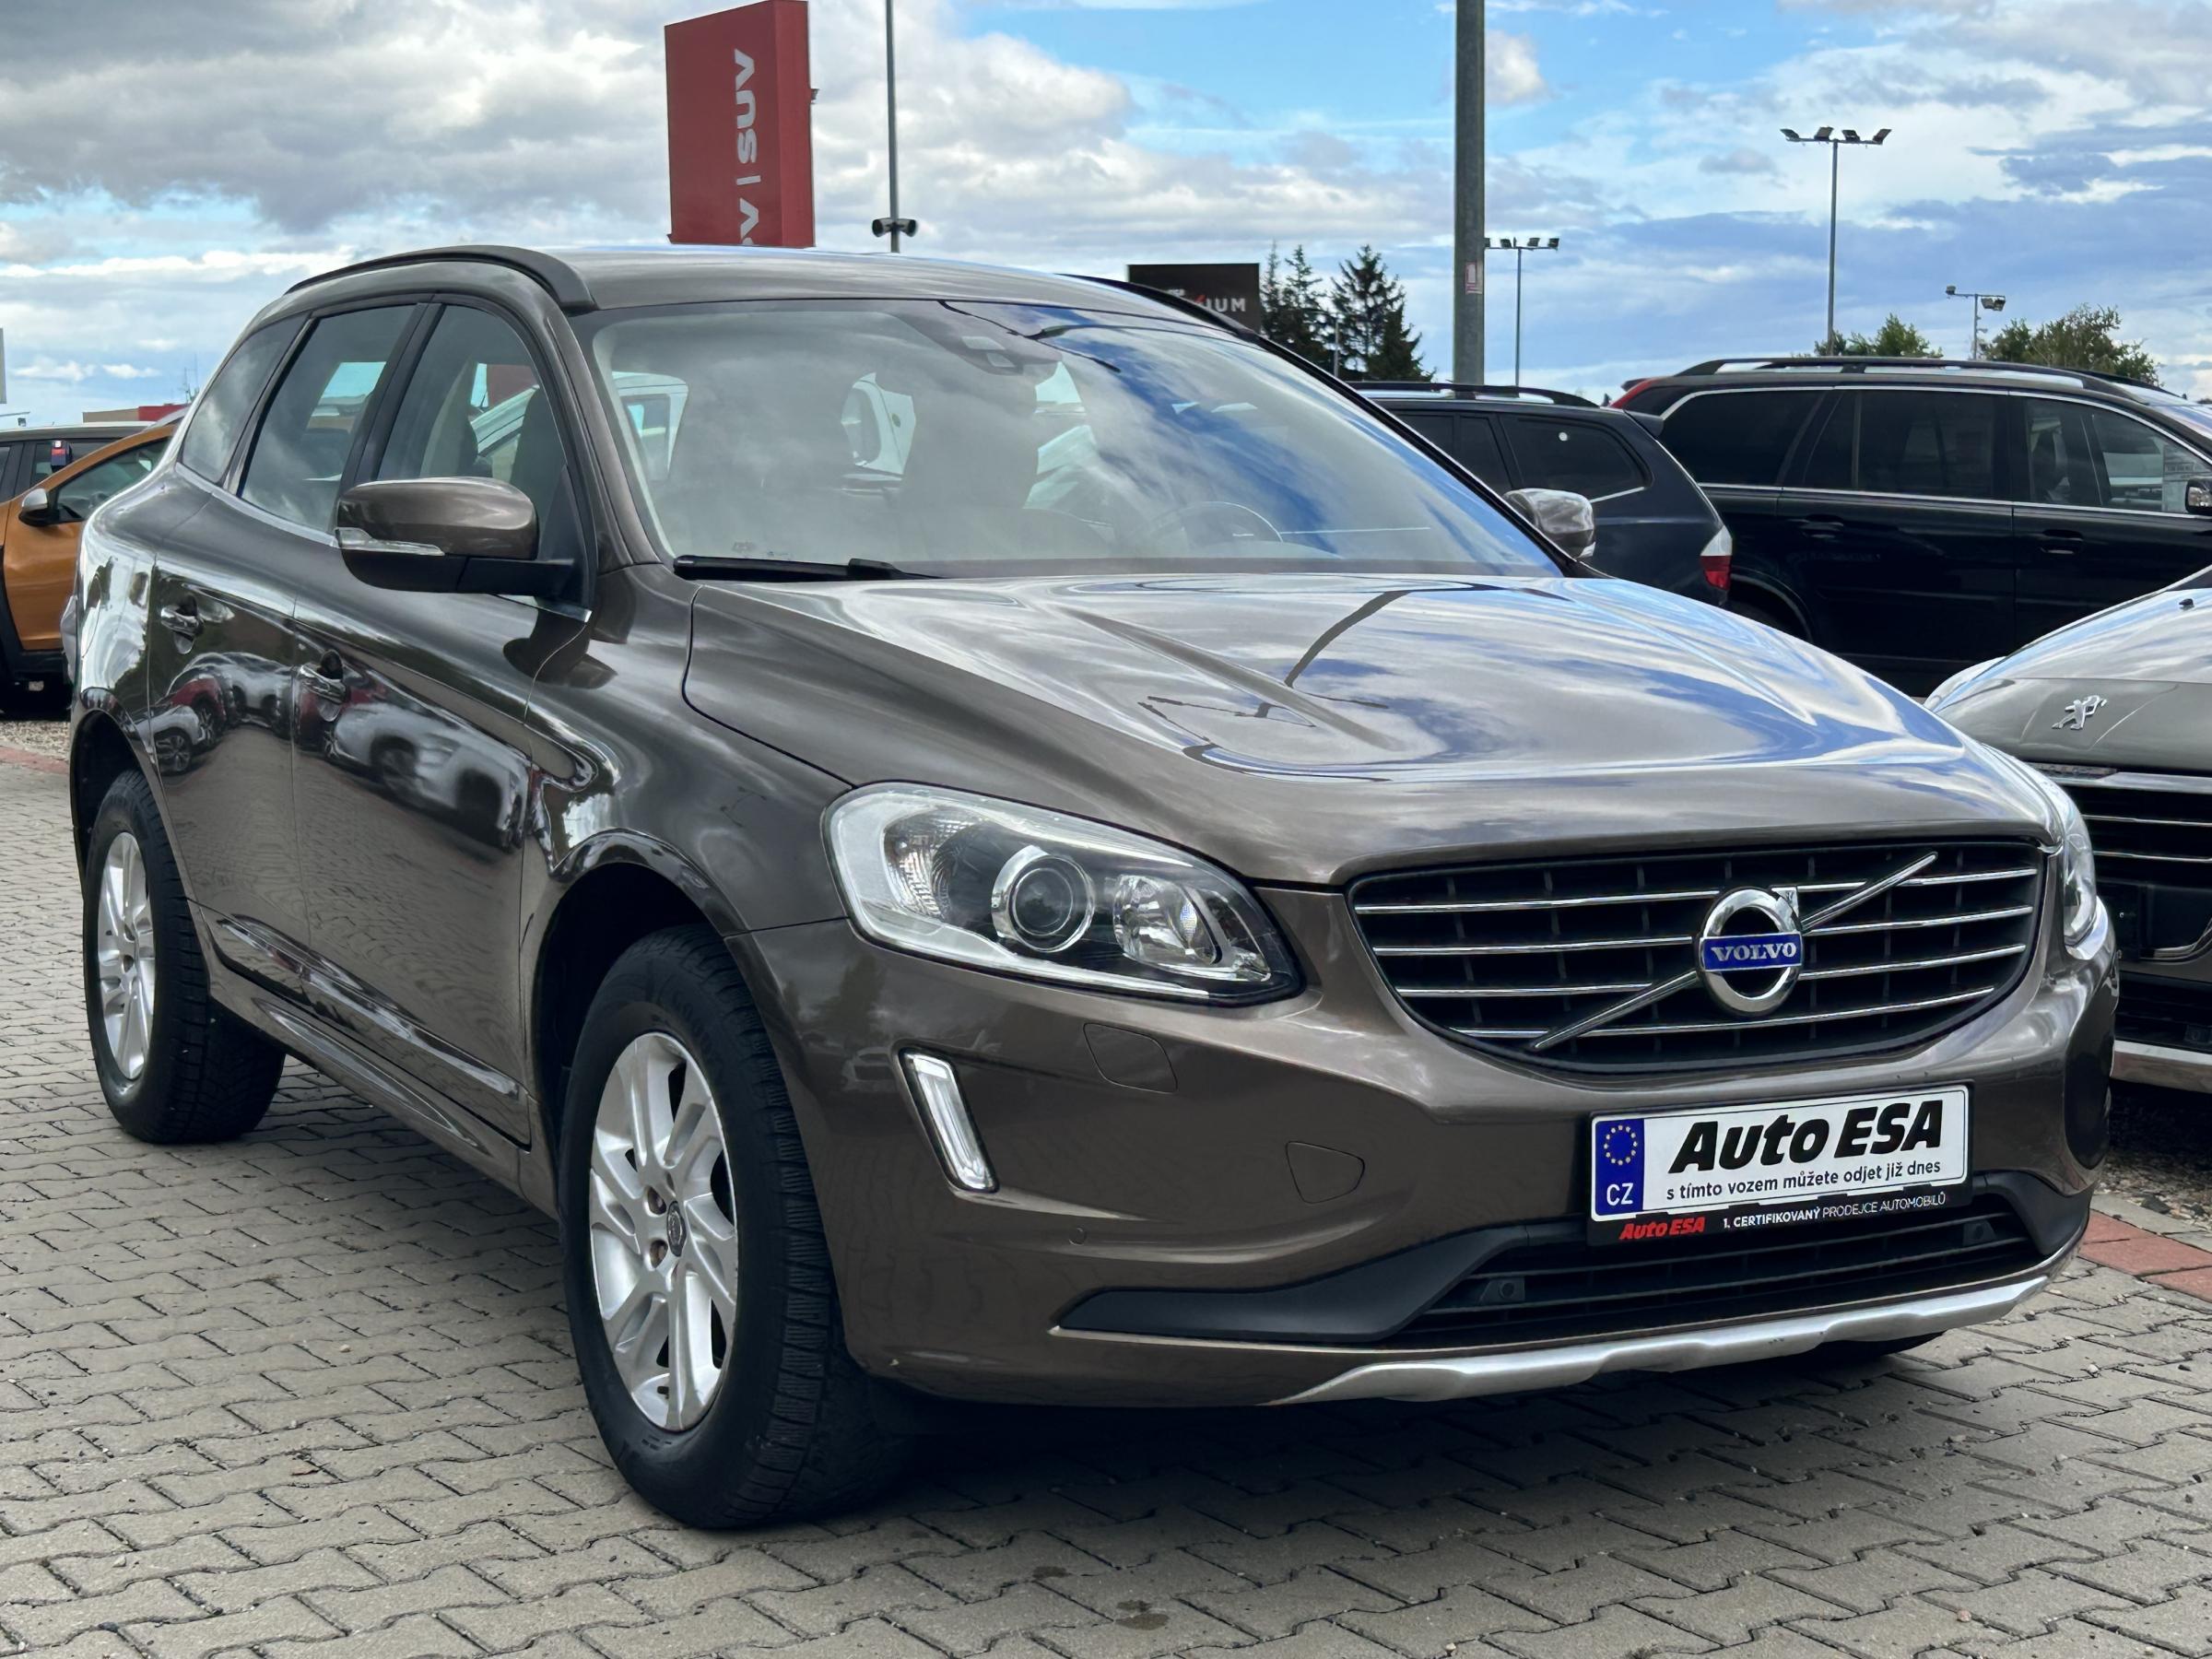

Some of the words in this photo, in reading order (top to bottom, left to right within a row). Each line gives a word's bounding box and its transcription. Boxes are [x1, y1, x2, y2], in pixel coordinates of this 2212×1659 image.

[734, 48, 758, 164] SUV
[1711, 942, 1796, 962] VOLVO
[1667, 1113, 1830, 1174] Auto
[1834, 1100, 1943, 1159] ESA
[1606, 1182, 1634, 1206] CZ
[1666, 1188, 1675, 1200] s
[1679, 1182, 1722, 1199] tímto
[1727, 1179, 1778, 1195] vozem
[1783, 1170, 1839, 1189] můžete
[1843, 1166, 1882, 1183] odjet
[1885, 1161, 1902, 1182] již
[1907, 1159, 1941, 1176] dnes
[1734, 1206, 1821, 1228] CERTIFIKOVANÝ
[1822, 1200, 1878, 1218] PRODEJCE
[1879, 1191, 1947, 1213] AUTOMOBILŮ
[1618, 1219, 1667, 1241] Auto
[1668, 1216, 1706, 1236] ESA
